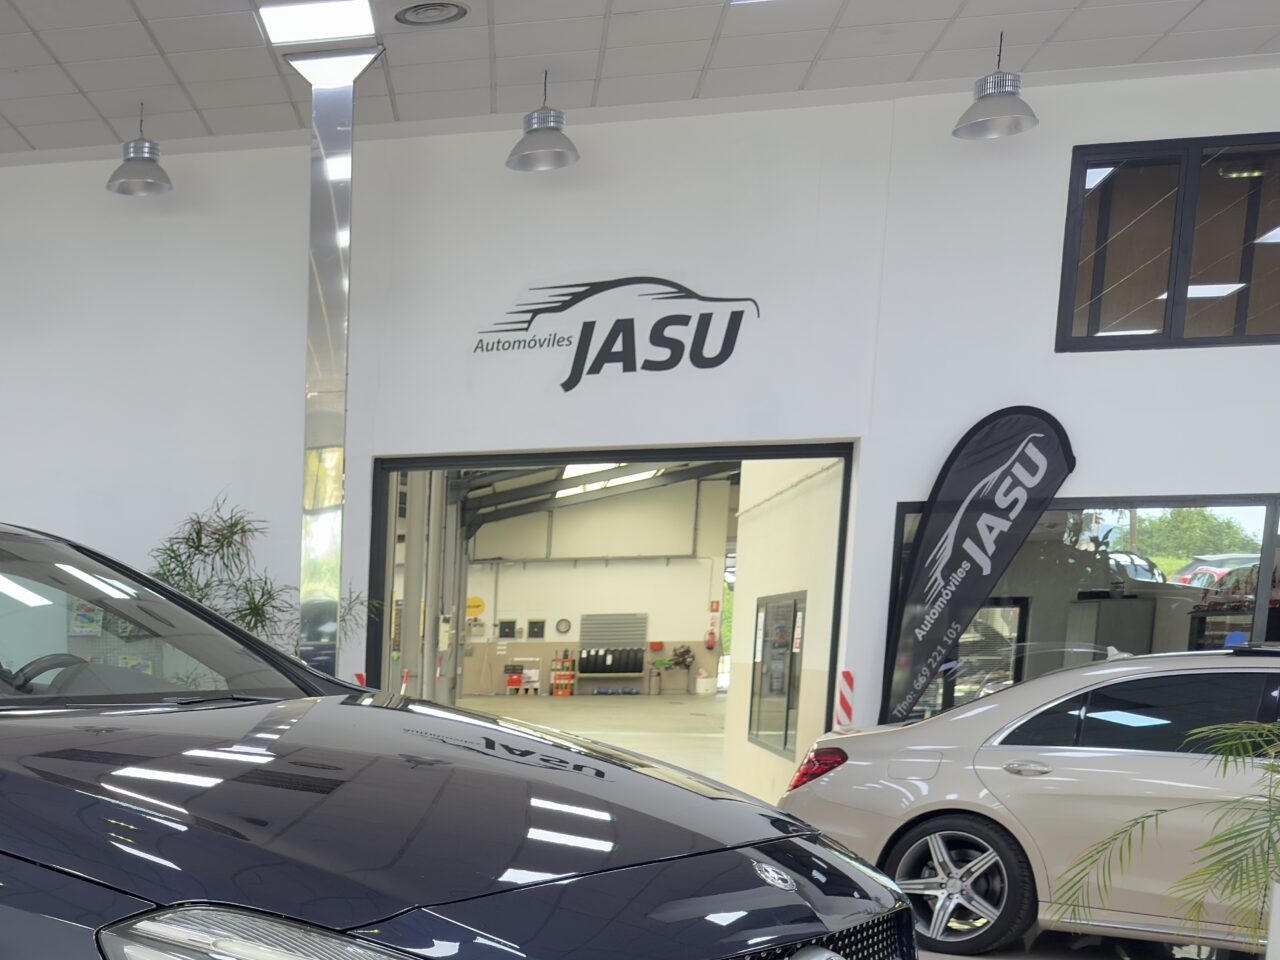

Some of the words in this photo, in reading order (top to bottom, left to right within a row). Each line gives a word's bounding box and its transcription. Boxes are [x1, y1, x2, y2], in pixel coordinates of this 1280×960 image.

[473, 333, 573, 353] Automóviles
[560, 310, 745, 392] JASU
[914, 559, 971, 642] Automóviles
[962, 442, 1048, 576] JASU
[913, 666, 930, 690] 669
[928, 645, 946, 669] 221
[943, 621, 961, 645] 105
